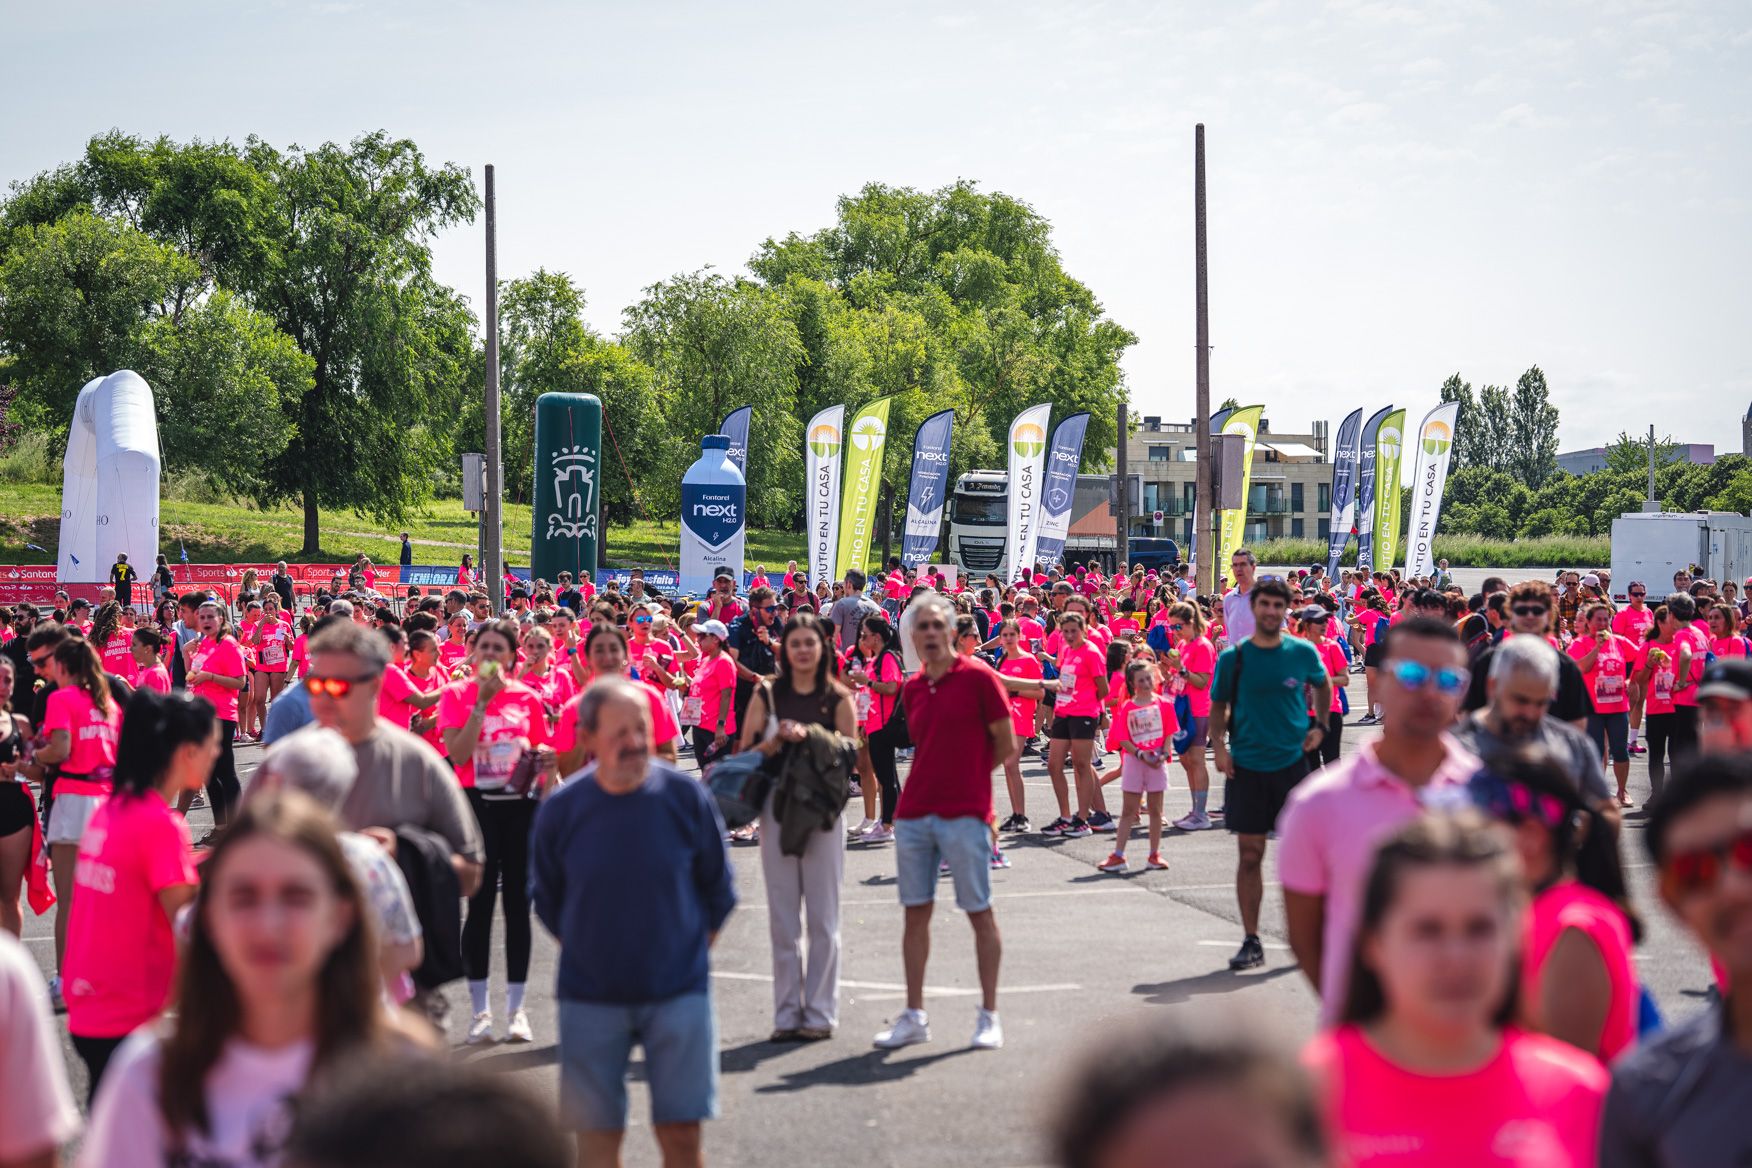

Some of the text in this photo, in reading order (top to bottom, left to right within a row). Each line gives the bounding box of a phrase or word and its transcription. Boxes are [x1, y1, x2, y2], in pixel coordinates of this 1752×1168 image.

[916, 451, 947, 462] next
[1052, 451, 1079, 463] next
[1336, 450, 1356, 459] next
[819, 465, 829, 497] CASA
[858, 458, 871, 493] CASA
[1021, 465, 1033, 499] CASA
[1425, 463, 1437, 497] CASA
[693, 503, 737, 517] next
[819, 501, 829, 517] TU
[856, 496, 867, 513] TU
[1020, 503, 1031, 519] TU
[1382, 502, 1391, 517] TU
[1422, 500, 1432, 517] TU
[819, 521, 829, 538] EN
[854, 517, 866, 535] EN
[1224, 521, 1233, 538] EN
[1382, 522, 1390, 538] EN
[1419, 522, 1429, 538] EN
[21, 569, 57, 579] Santan
[118, 568, 127, 581] 7
[196, 568, 225, 577] Sports
[307, 567, 335, 578] Sports
